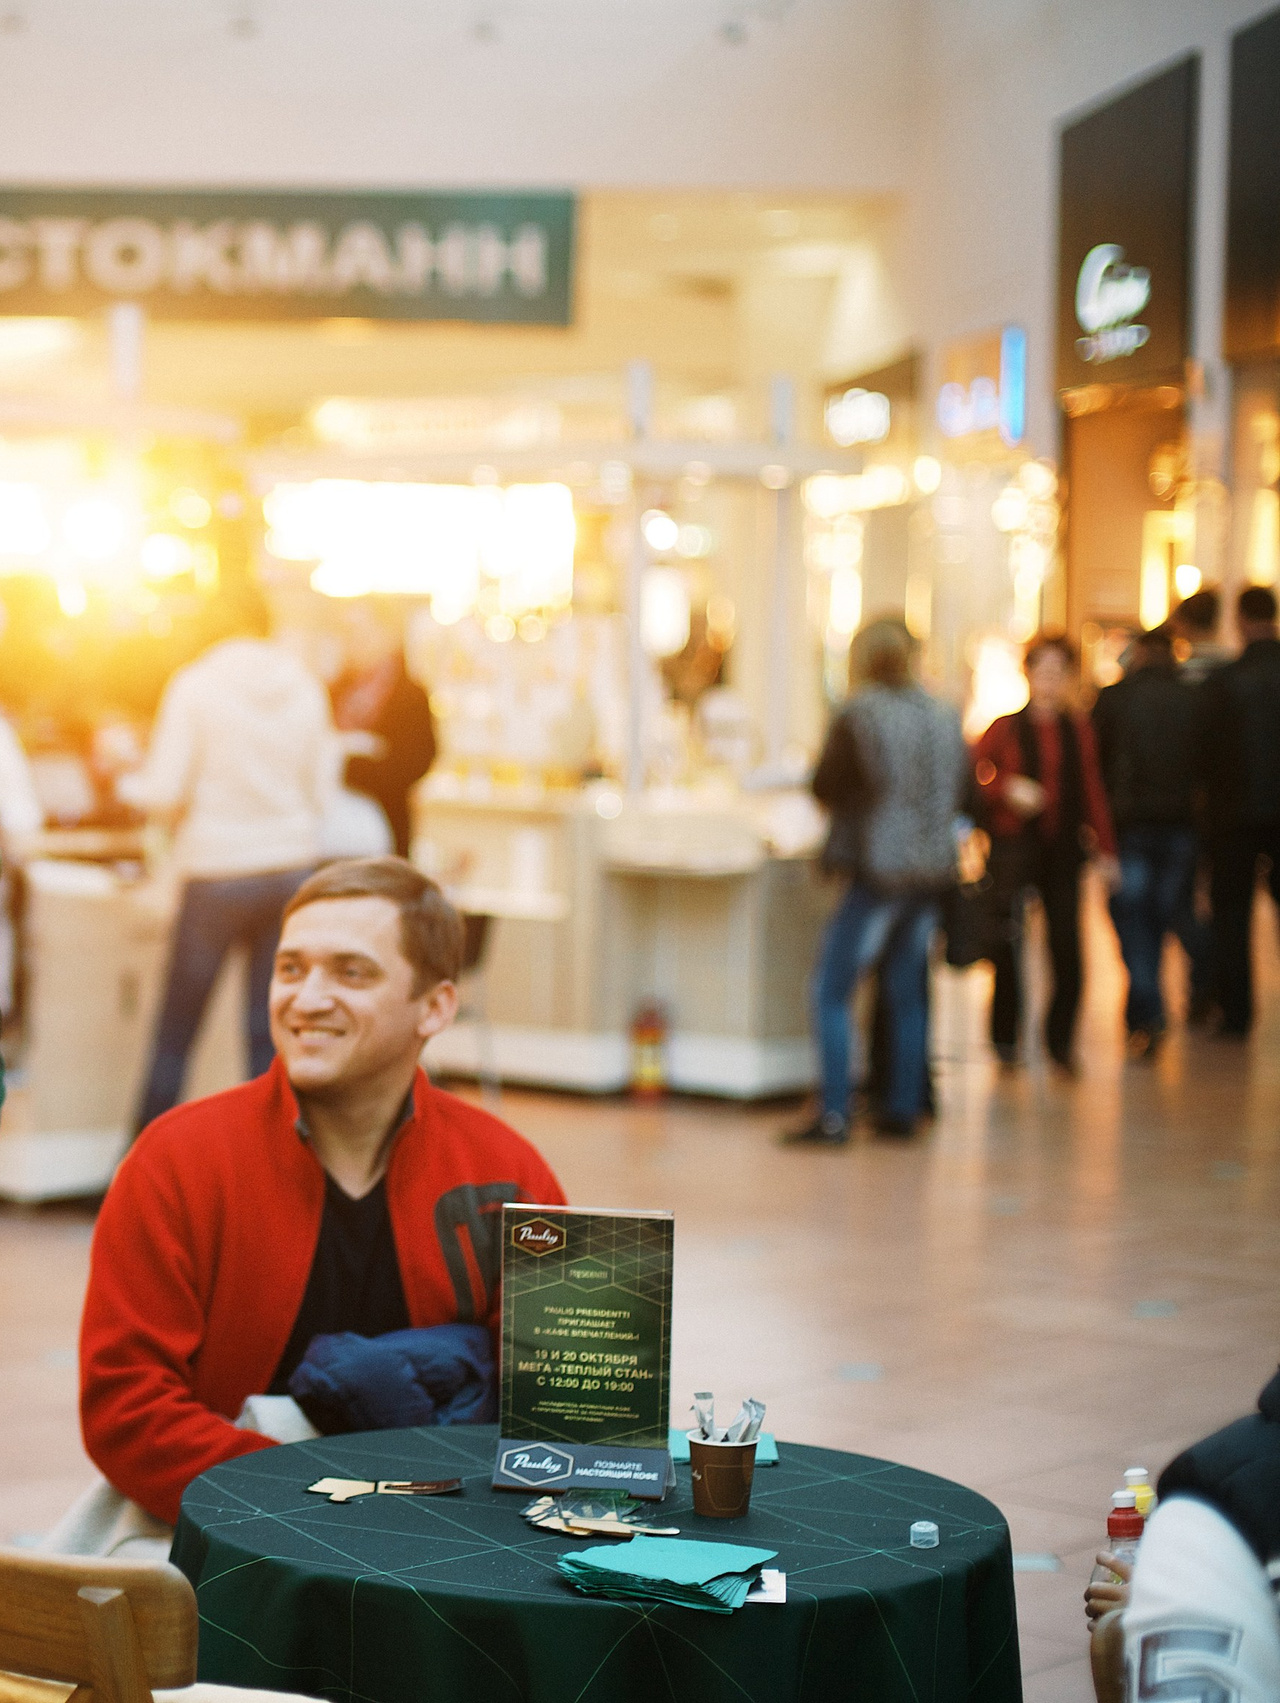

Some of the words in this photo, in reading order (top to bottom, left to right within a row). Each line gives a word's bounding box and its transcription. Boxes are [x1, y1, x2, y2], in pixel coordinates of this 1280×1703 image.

[520, 1226, 559, 1245] Paulig
[544, 1306, 574, 1315] PAULIG
[576, 1308, 631, 1319] PRESIDENTTI
[558, 1318, 616, 1328] ПРИГЛАШАЕТ
[534, 1327, 540, 1335] В
[535, 1350, 548, 1359] 19
[551, 1351, 560, 1360] И
[562, 1352, 577, 1361] 20
[579, 1353, 638, 1365] ОКТЯБРЯ
[518, 1362, 551, 1373] МЕГА
[537, 1377, 546, 1386] С
[550, 1377, 579, 1388] 12:00
[582, 1380, 601, 1391] ДО
[604, 1382, 634, 1392] 19:00
[512, 1453, 562, 1474] Paulig
[594, 1460, 642, 1470] ПОЗНАЙТЕ
[575, 1468, 632, 1479] НАСТОЯЩИЙ
[632, 1472, 659, 1481] КОФЕ
